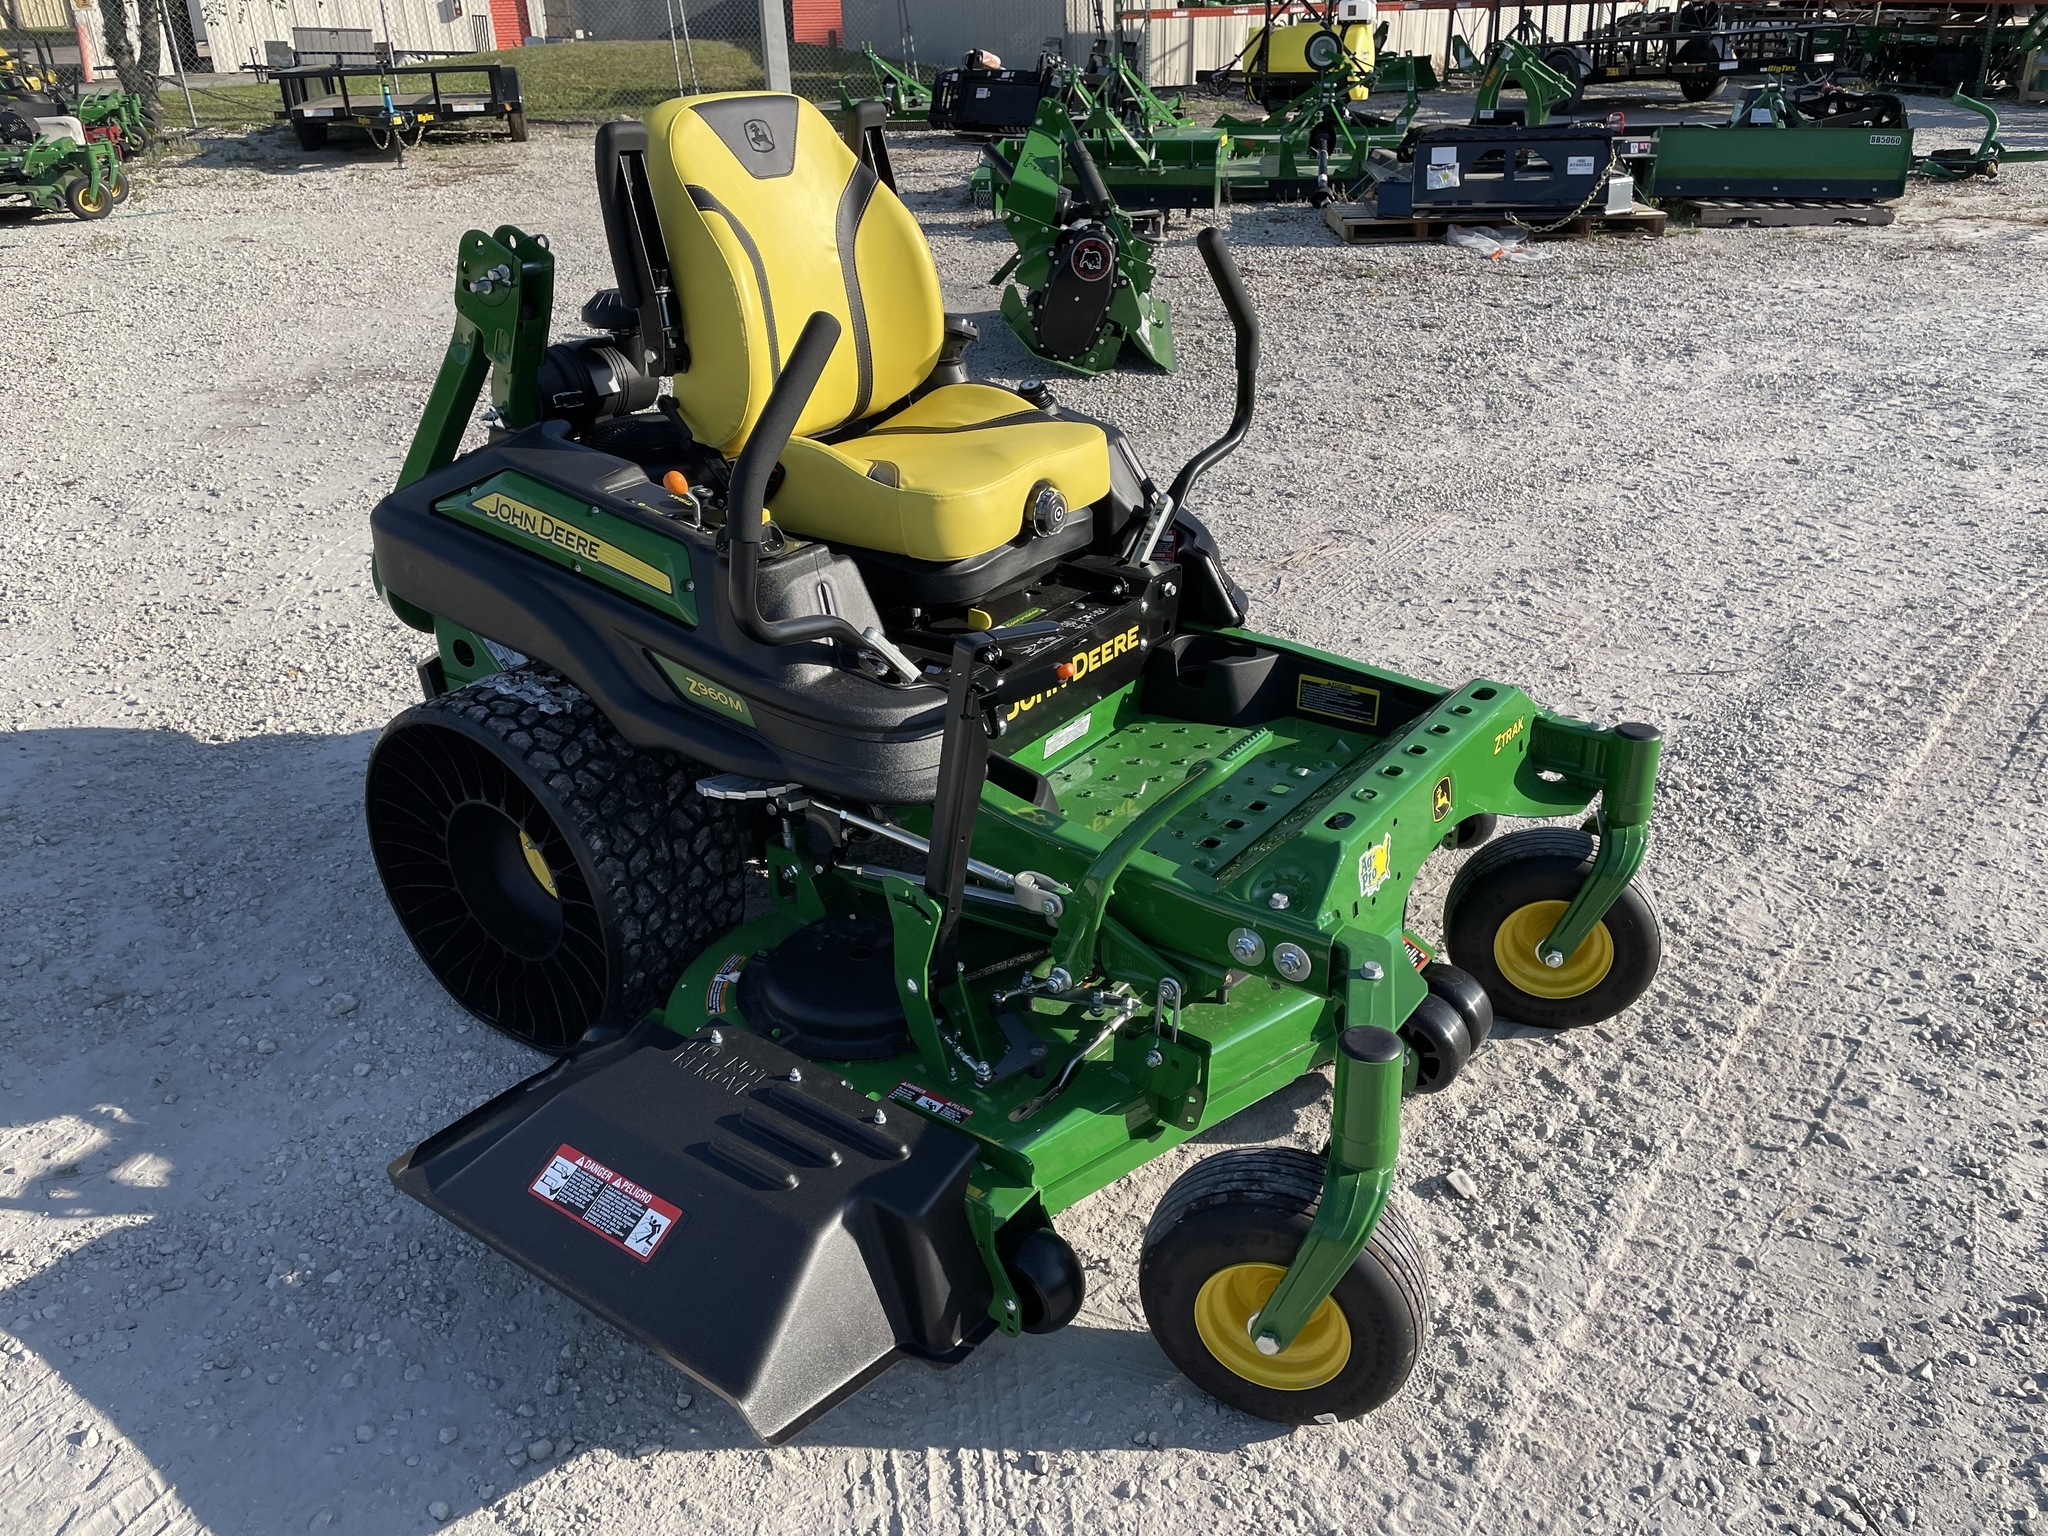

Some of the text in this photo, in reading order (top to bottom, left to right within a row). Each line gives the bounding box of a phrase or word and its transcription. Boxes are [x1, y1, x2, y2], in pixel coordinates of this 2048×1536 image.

[488, 497, 600, 560] JOHN DEERE
[1072, 624, 1140, 682] DEERE
[685, 676, 743, 713] Z960M
[1494, 715, 1525, 756] ZTRAK
[906, 1083, 927, 1095] DANGER
[950, 1102, 974, 1116] PELIGRO
[583, 1159, 613, 1182] DANGER
[620, 1180, 653, 1205] PELIGRO
